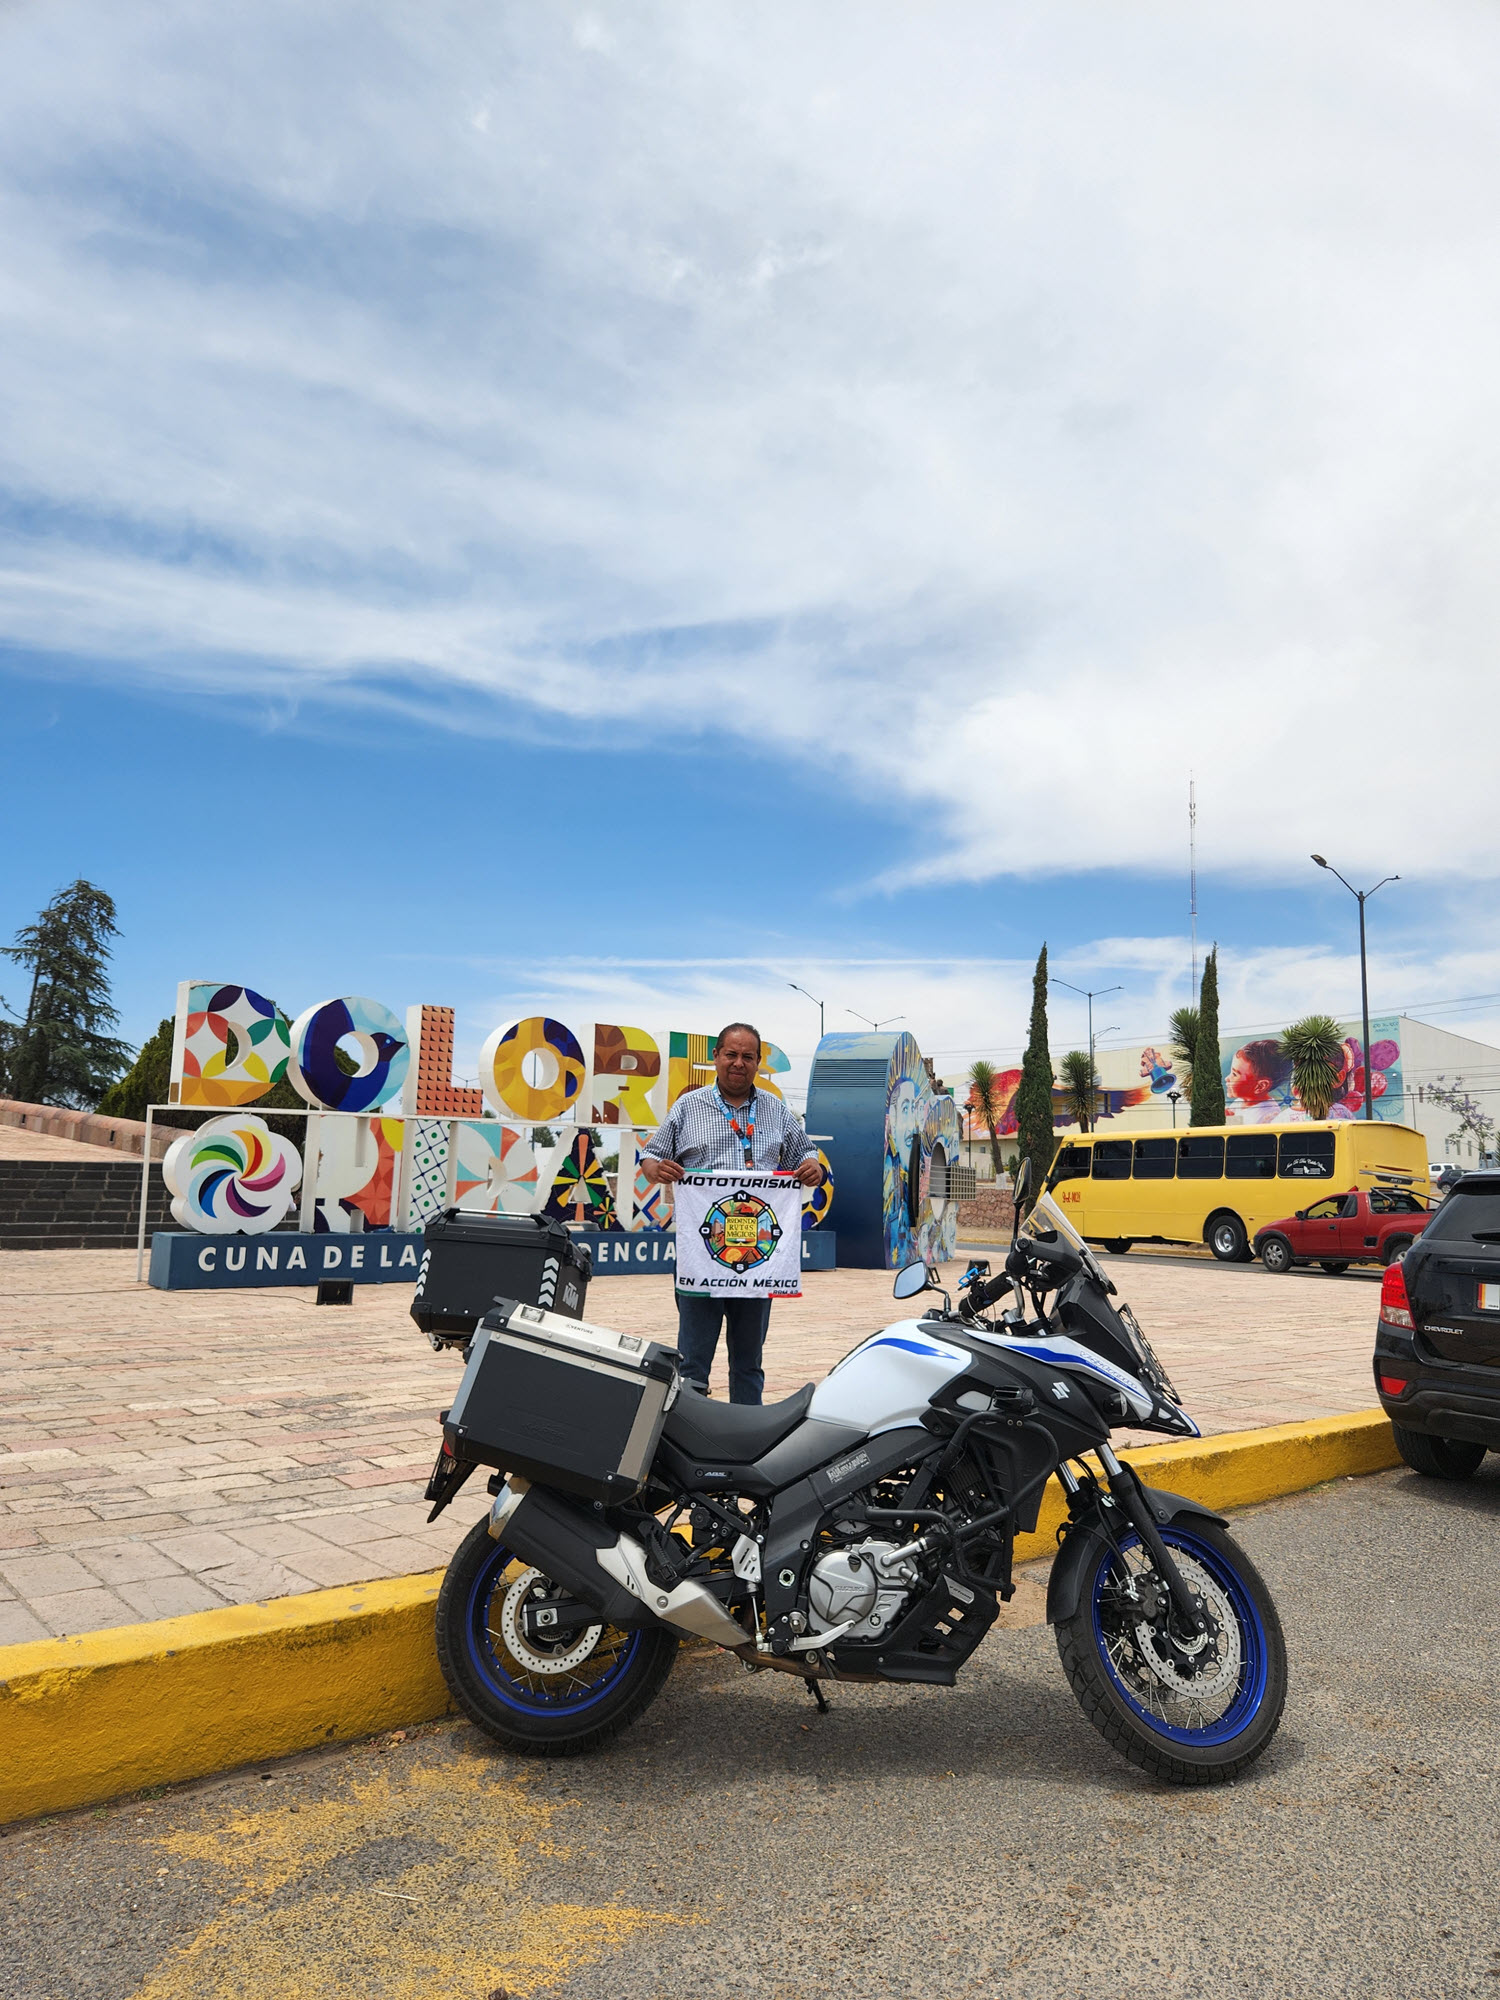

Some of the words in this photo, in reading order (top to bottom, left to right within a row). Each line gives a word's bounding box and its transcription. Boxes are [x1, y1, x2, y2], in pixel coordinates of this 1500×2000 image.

[678, 1176, 802, 1189] MOTOTURISMO
[198, 1246, 307, 1272] CUNA
[323, 1245, 365, 1268] DE
[380, 1245, 418, 1267] LA
[736, 1263, 744, 1271] S
[679, 1277, 695, 1286] EN
[700, 1276, 747, 1287] ACCIÓN
[753, 1276, 798, 1288] MÉXICO
[562, 1281, 579, 1310] KTM
[1424, 1325, 1464, 1335] CHEVROLET
[834, 1585, 865, 1593] SUZUKI
